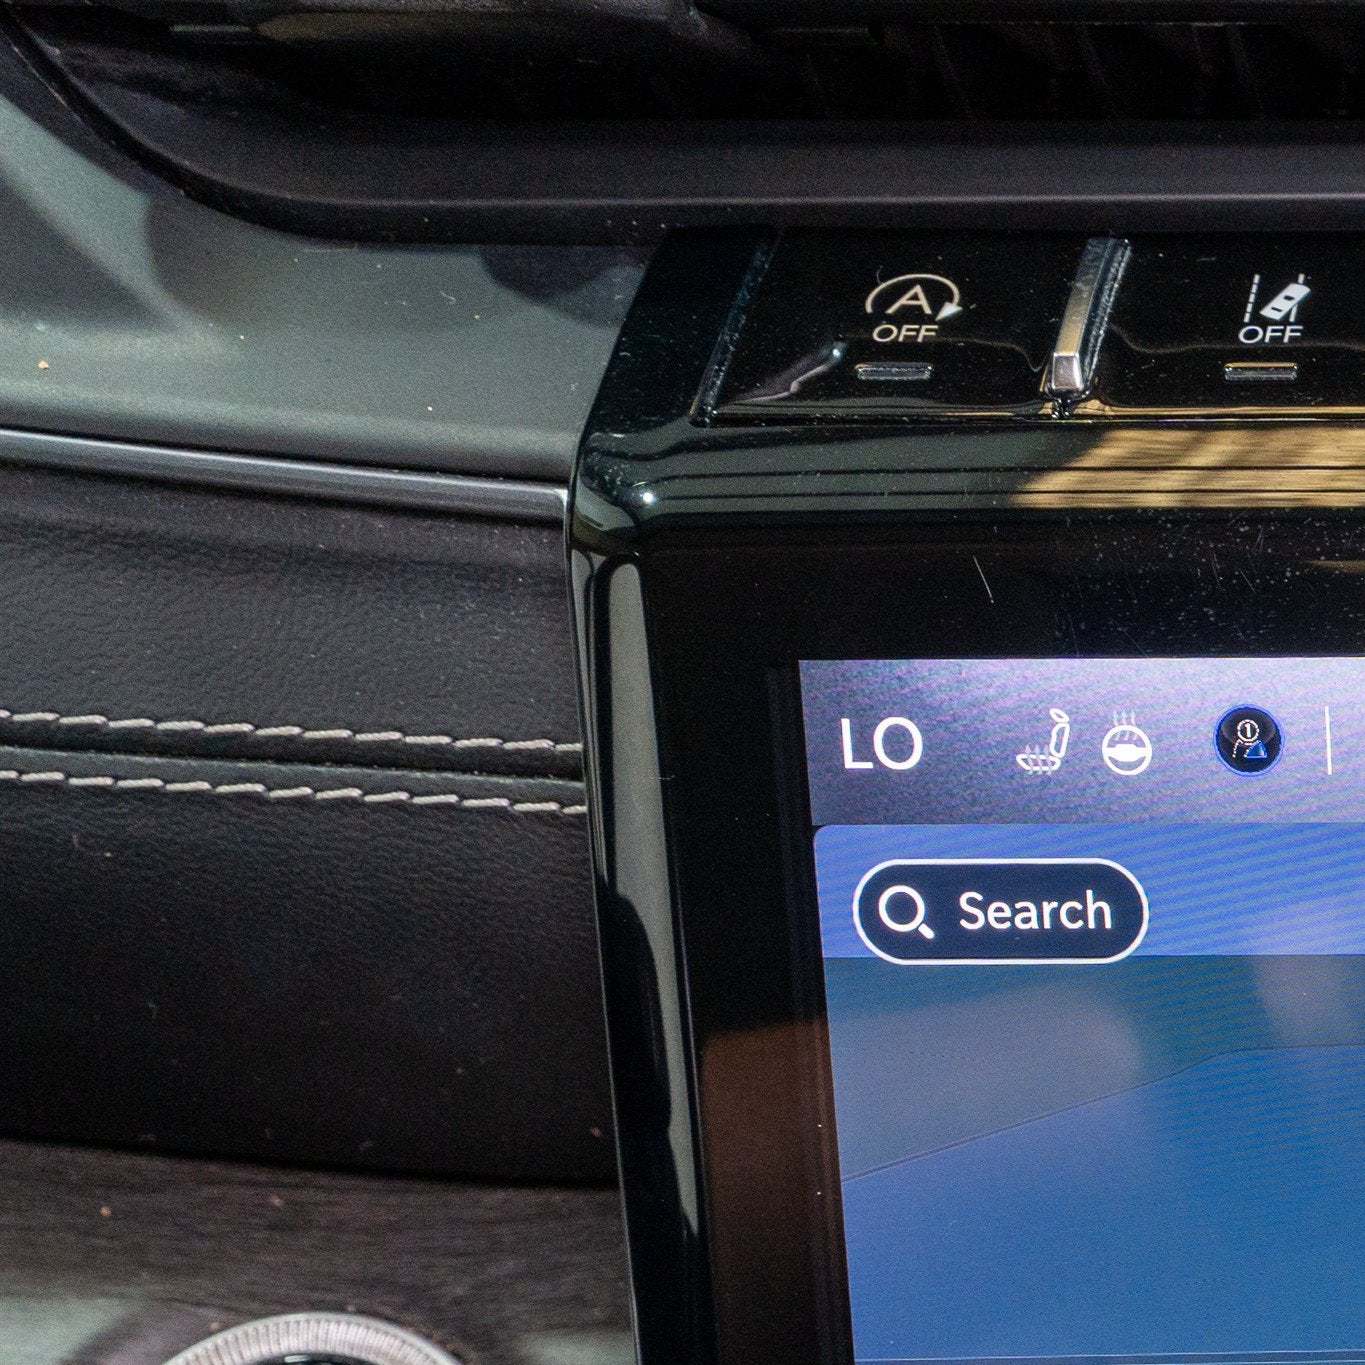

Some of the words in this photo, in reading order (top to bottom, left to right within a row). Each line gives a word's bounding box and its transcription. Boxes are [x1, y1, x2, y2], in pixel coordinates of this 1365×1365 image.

[873, 325, 938, 342] OFF
[1239, 326, 1303, 344] OFF
[841, 717, 923, 770] LO
[959, 890, 1112, 930] Search
